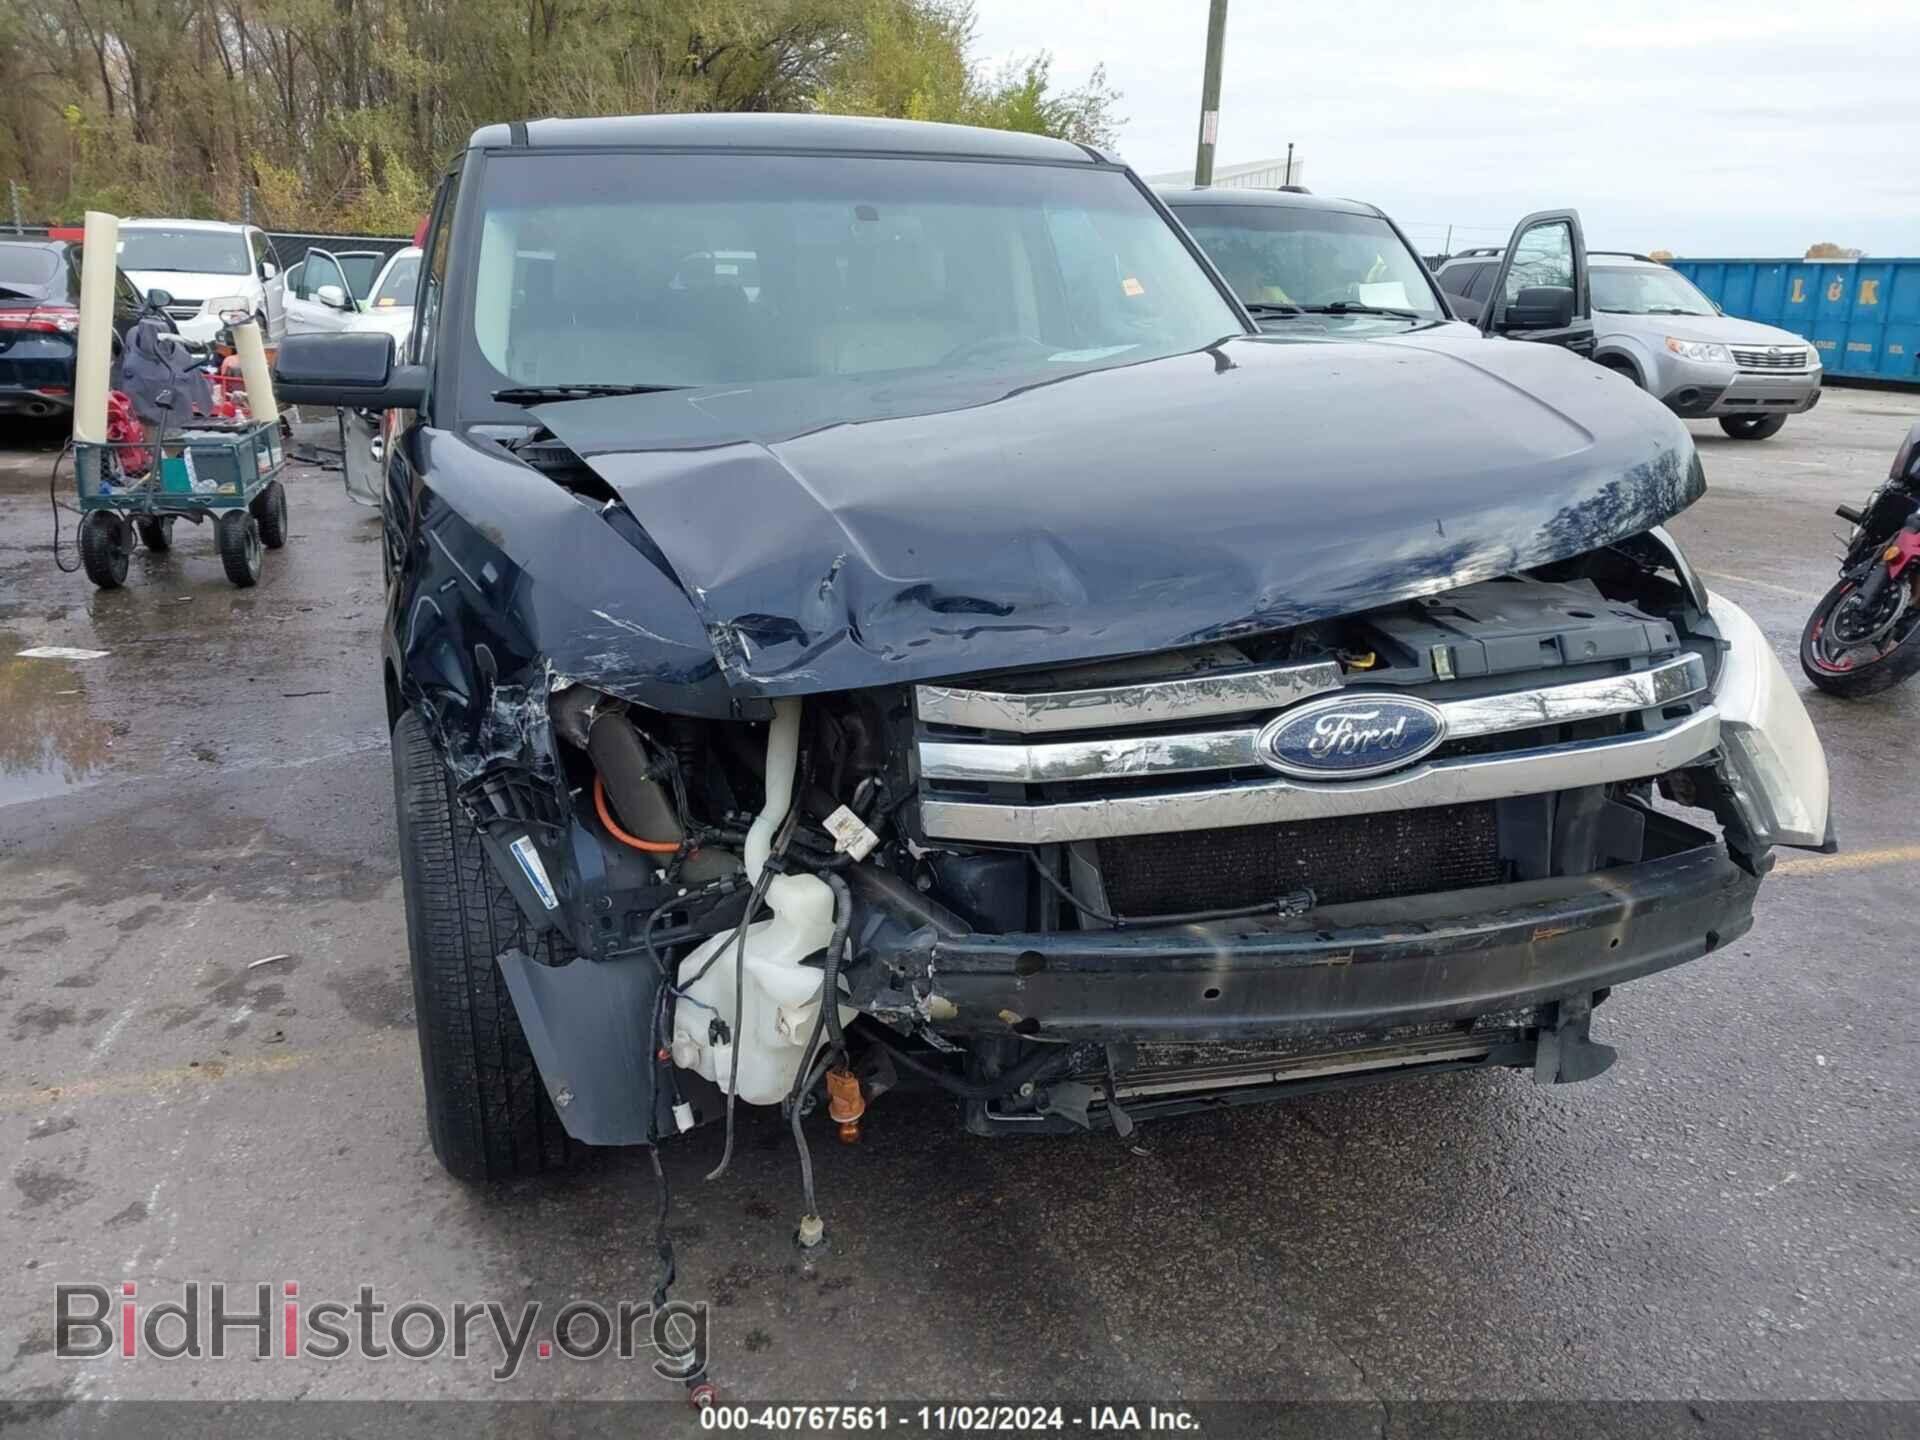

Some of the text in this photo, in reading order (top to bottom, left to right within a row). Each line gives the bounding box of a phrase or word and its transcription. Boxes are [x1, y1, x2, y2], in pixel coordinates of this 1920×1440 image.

[1791, 279, 1806, 303] L
[1859, 279, 1879, 304] K
[1308, 710, 1407, 758] Ford
